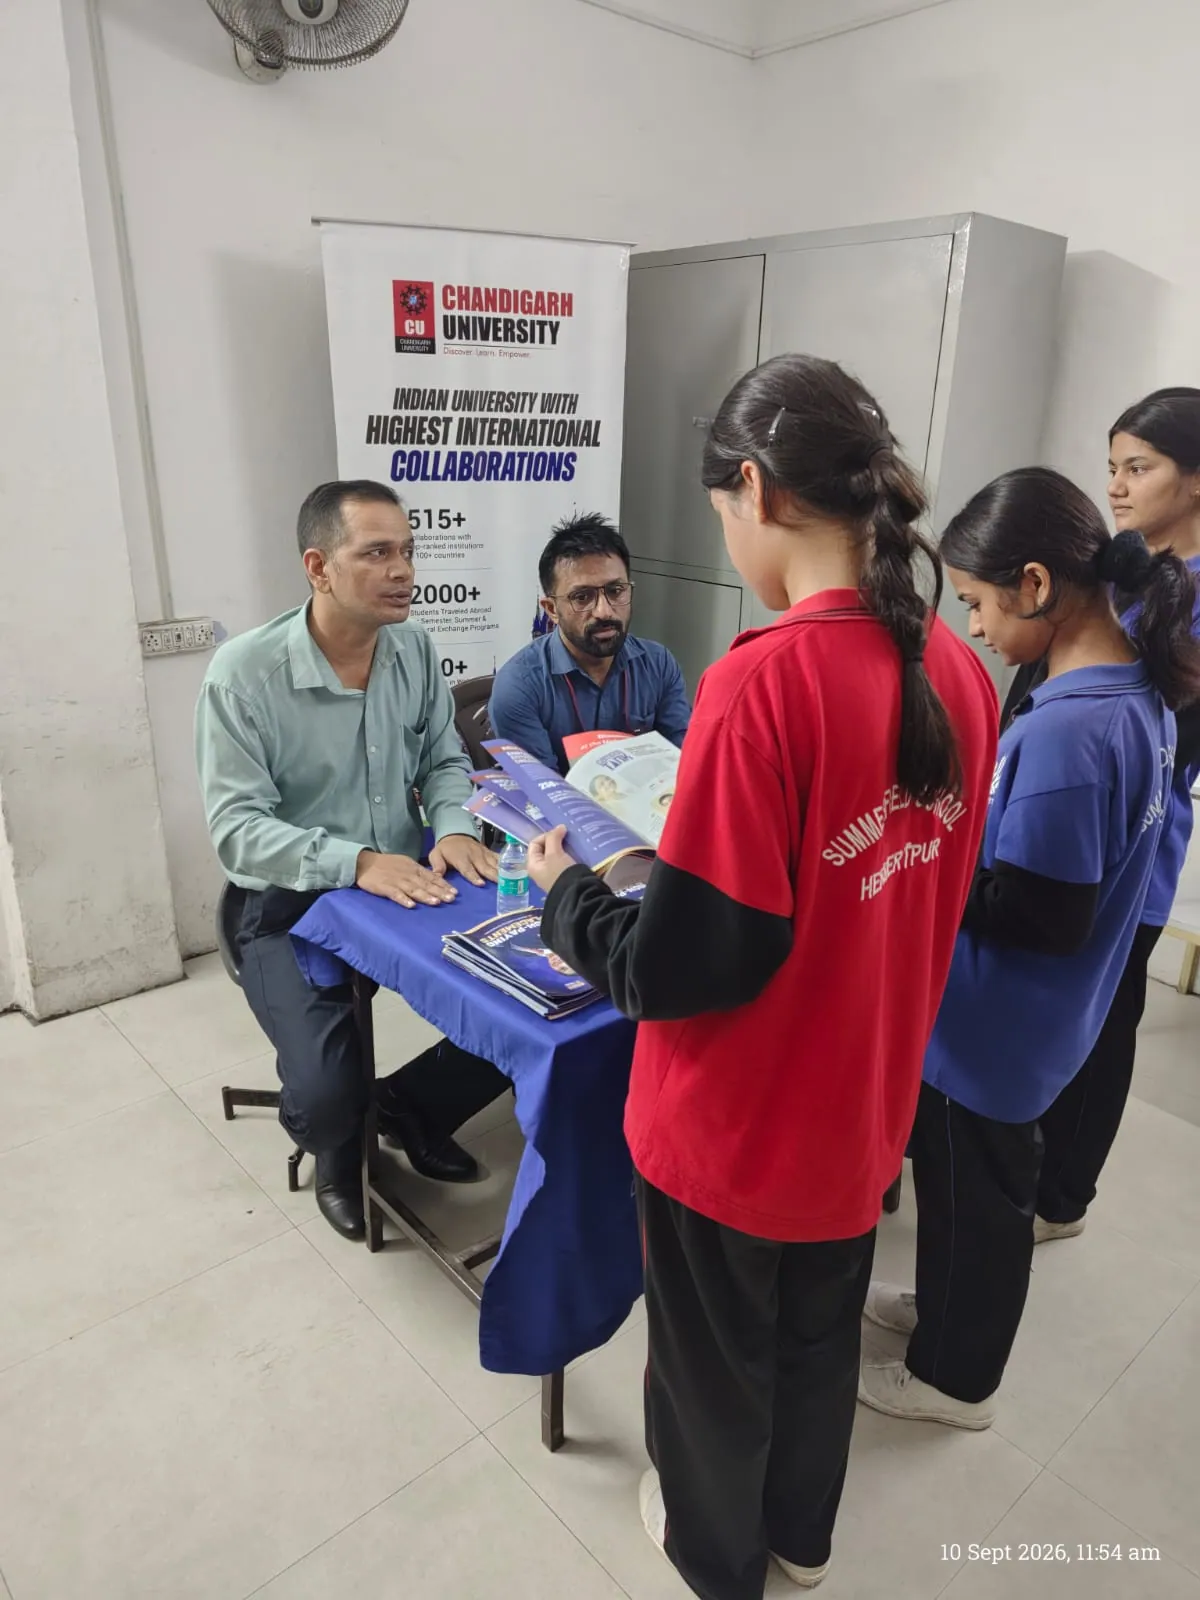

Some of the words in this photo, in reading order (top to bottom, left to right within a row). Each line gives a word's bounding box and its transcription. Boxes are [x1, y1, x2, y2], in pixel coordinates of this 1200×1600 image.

[442, 284, 573, 317] CHANDIGARH
[404, 320, 425, 336] CU
[443, 314, 560, 345] UNIVERSITY
[393, 387, 449, 412] INDIAN
[451, 389, 538, 414] UNIVERSITY
[540, 392, 579, 415] WITH
[366, 415, 453, 446] HIGHEST
[455, 417, 601, 448] INTERNATIONAL
[390, 449, 577, 482] COLLABORATIONS
[408, 508, 466, 530] 515+
[415, 543, 446, 551] p-ranked
[458, 533, 472, 541] with
[411, 583, 481, 605] 2000+
[410, 608, 439, 617] Students
[441, 607, 468, 616] Traveled
[470, 605, 492, 614] Abroad
[454, 616, 480, 624] Summer
[438, 625, 469, 633] Exchange
[470, 623, 500, 632] Programs
